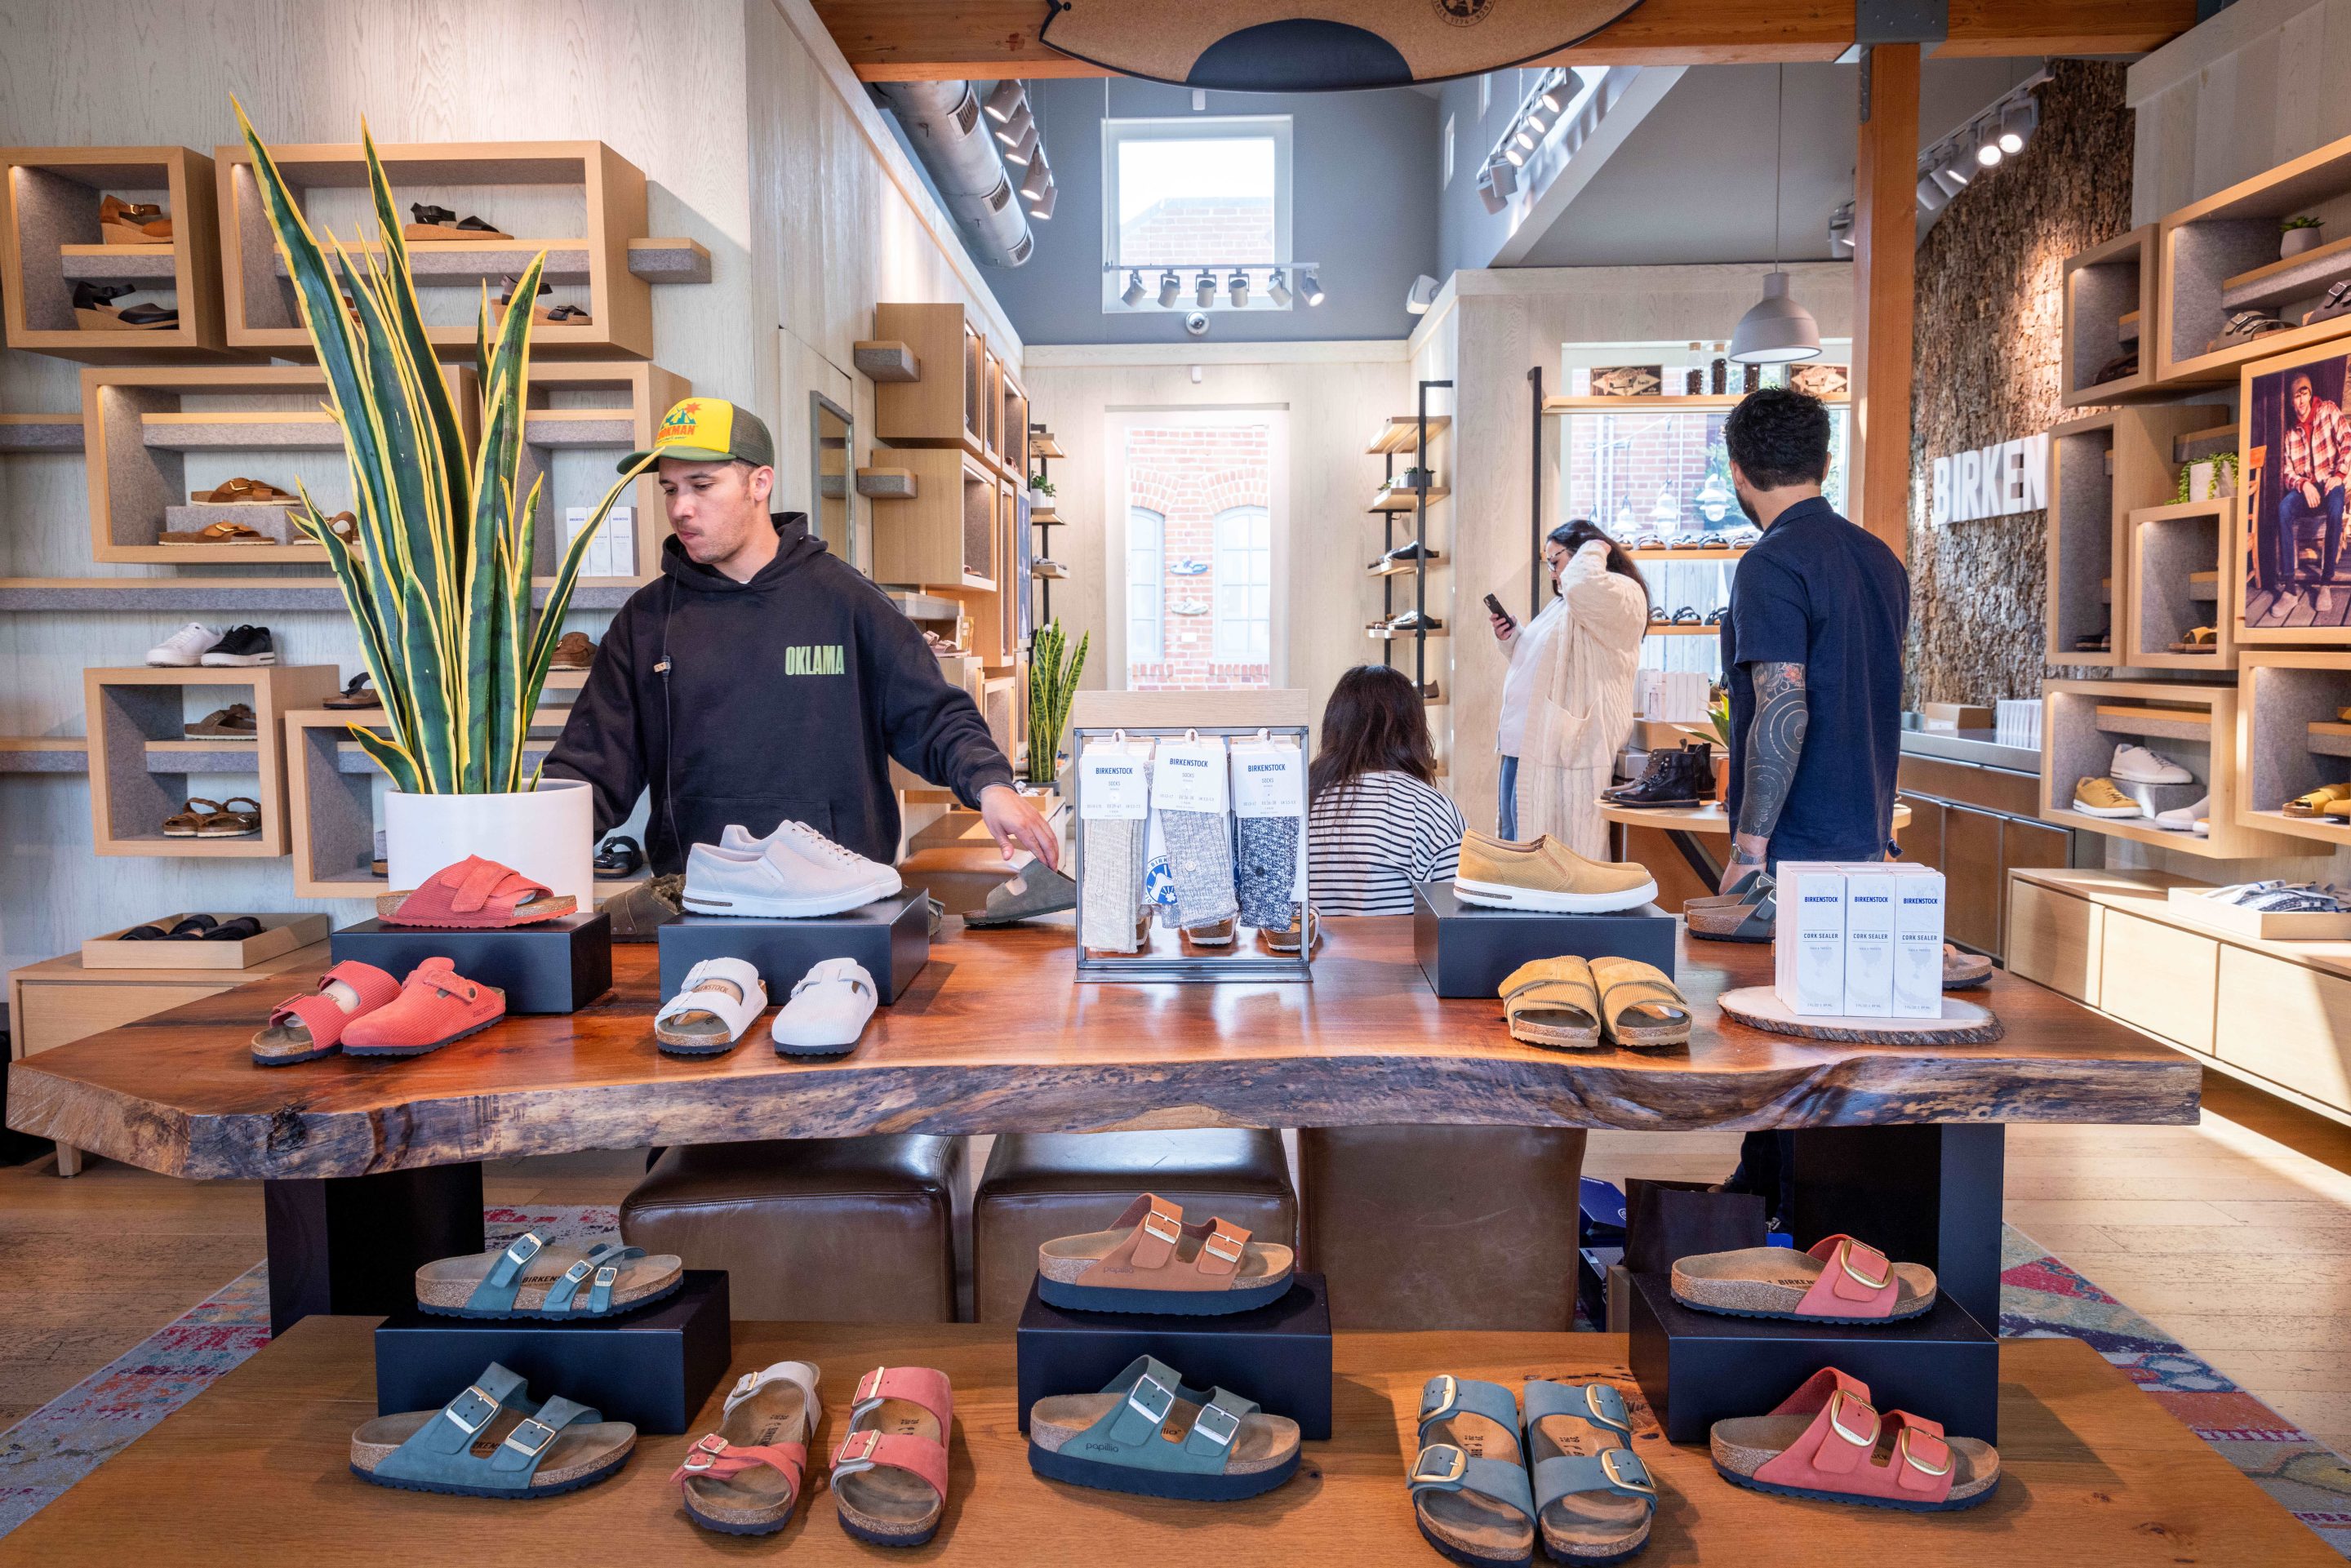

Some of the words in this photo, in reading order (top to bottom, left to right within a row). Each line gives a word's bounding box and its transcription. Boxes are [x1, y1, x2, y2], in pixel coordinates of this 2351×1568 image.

[1933, 433, 2049, 526] BIRKEN
[784, 645, 845, 676] OKLAMA
[1169, 757, 1208, 768] BIRKENSTOCK
[1247, 763, 1286, 772] BIRKENSTOCK
[1086, 1442, 1119, 1452] papillio
